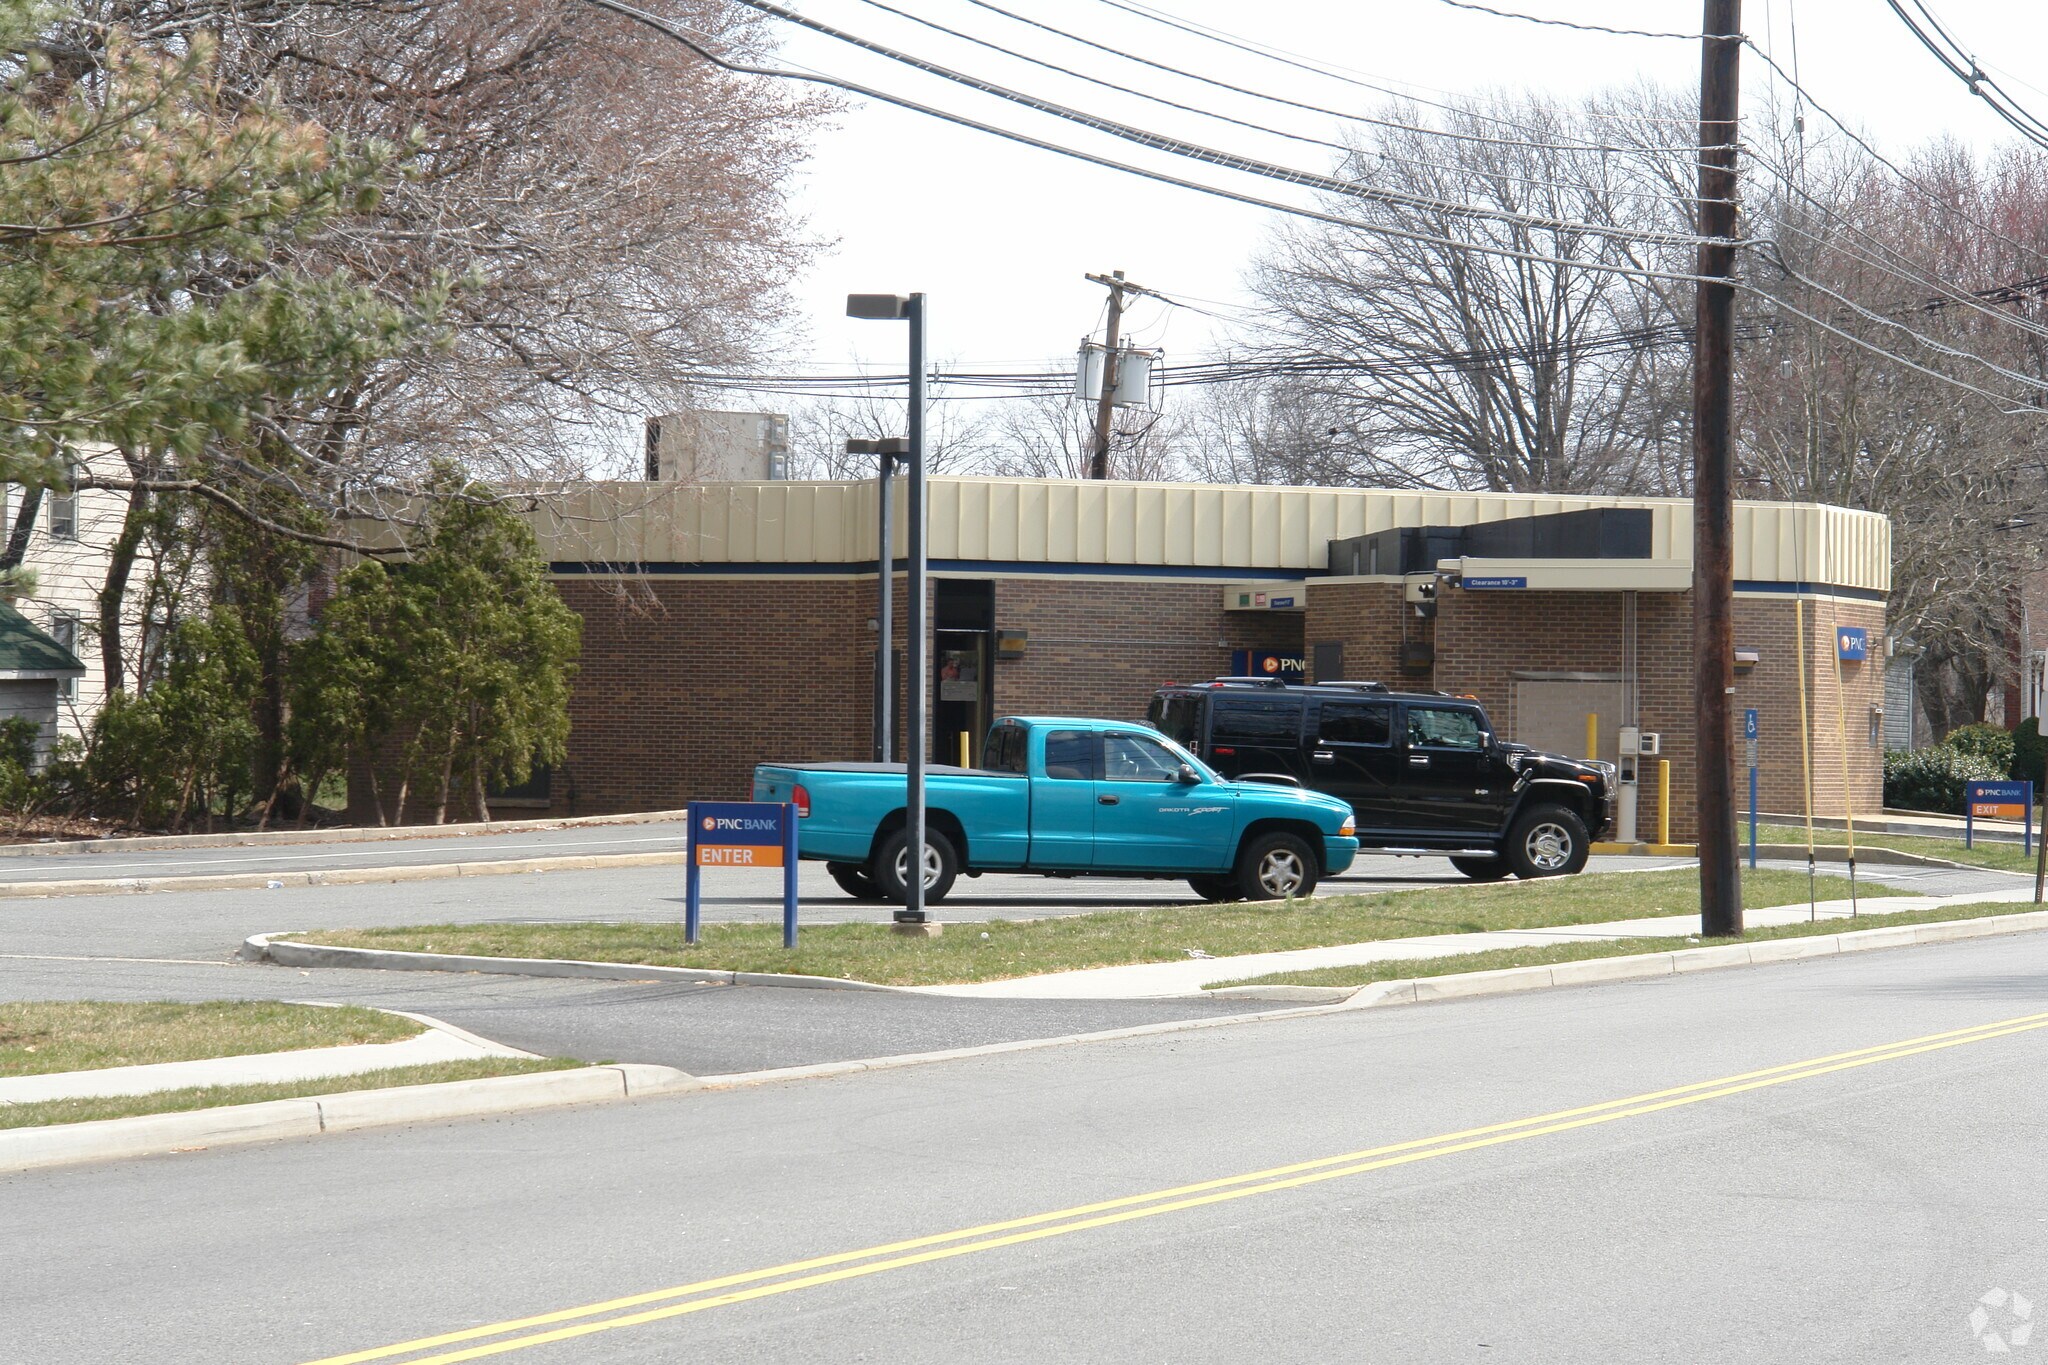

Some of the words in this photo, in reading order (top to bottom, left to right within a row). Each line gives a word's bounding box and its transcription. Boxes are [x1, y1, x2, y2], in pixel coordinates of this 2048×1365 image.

[1850, 637, 1866, 651] PNC
[1976, 805, 1999, 814] EXIT
[701, 848, 753, 864] ENTER
